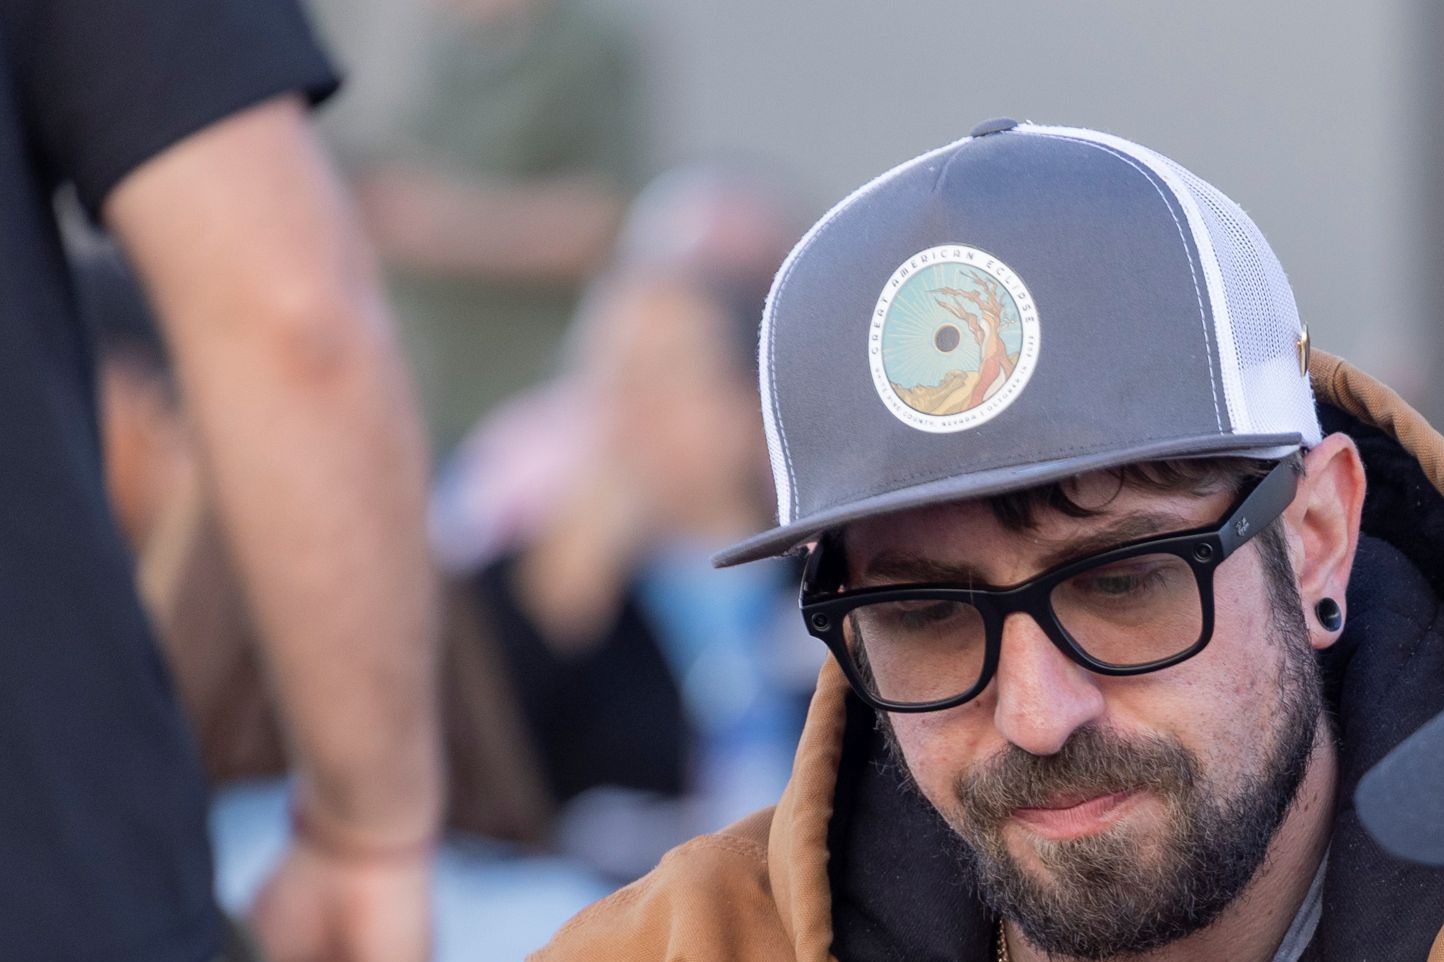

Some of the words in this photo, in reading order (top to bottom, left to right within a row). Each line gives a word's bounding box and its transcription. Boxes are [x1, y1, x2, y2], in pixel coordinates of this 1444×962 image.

[871, 298, 889, 355] GREAT
[891, 250, 975, 288] AMERICAN
[985, 260, 1035, 323] ECLIPSE
